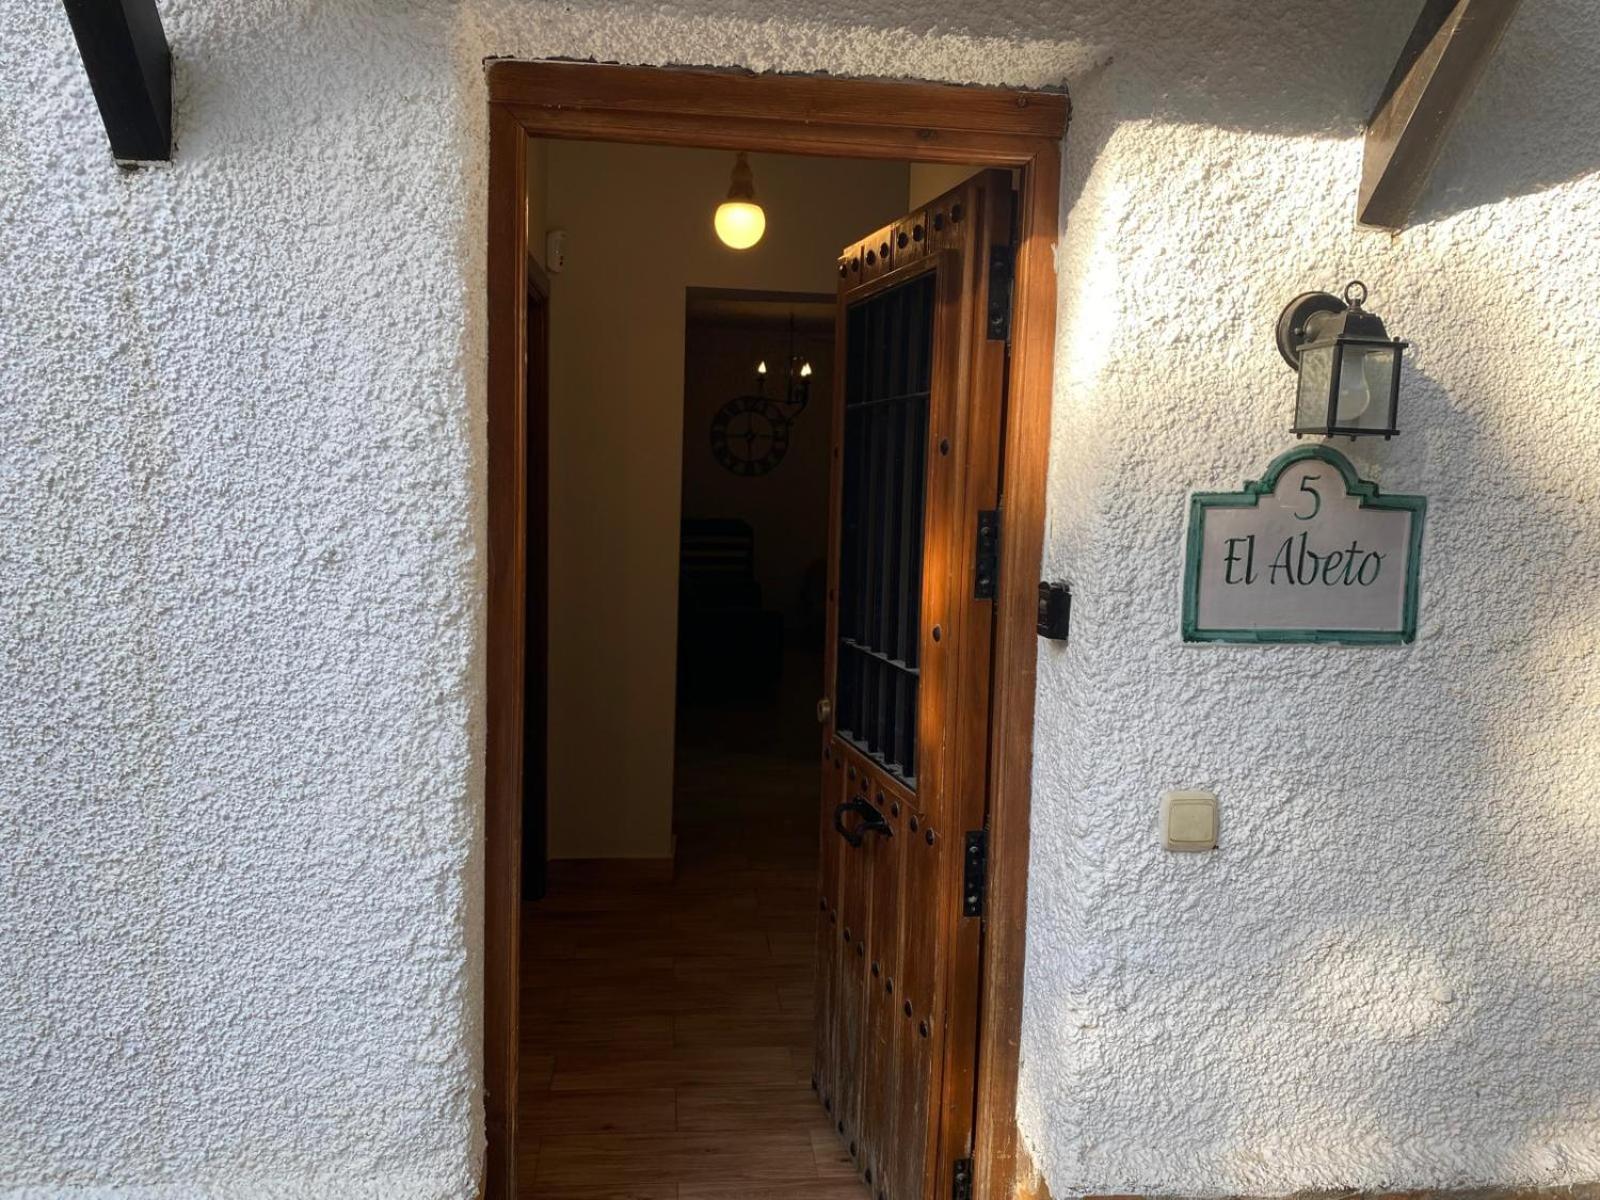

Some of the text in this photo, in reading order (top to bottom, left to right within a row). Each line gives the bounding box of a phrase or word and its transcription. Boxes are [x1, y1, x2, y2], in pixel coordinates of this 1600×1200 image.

[1294, 474, 1322, 521] 5
[1223, 531, 1386, 587] El Abeto
